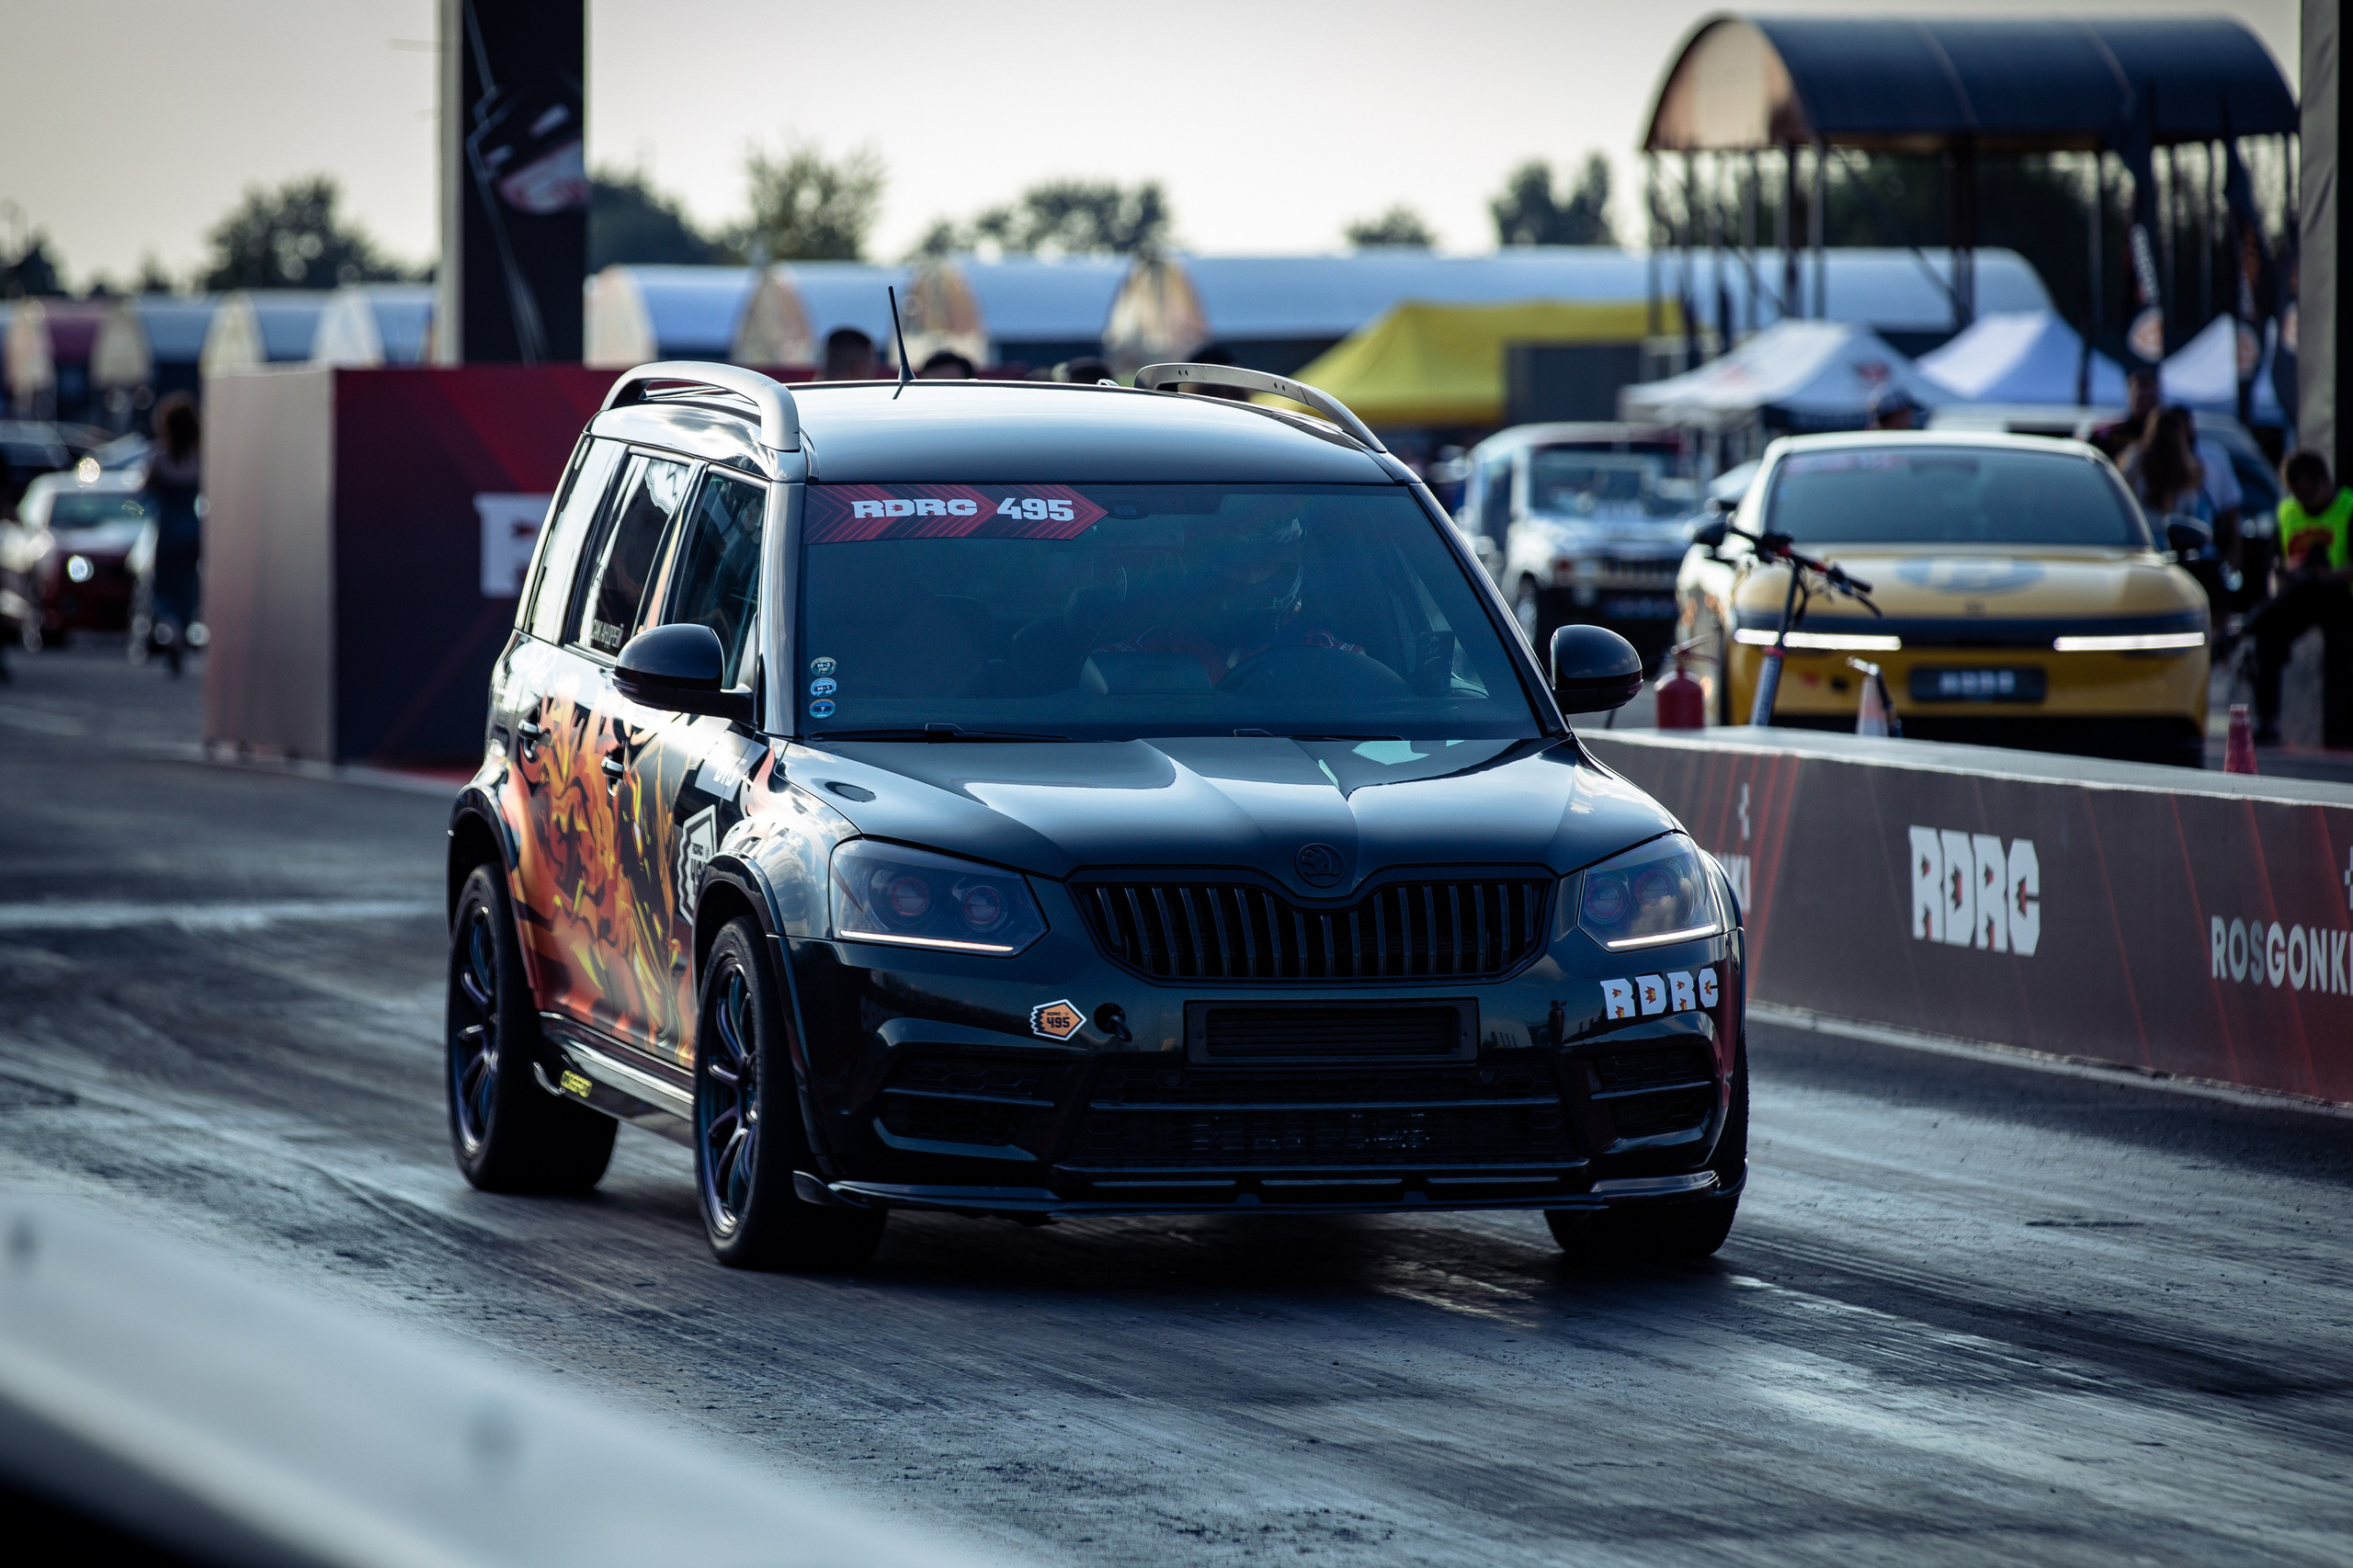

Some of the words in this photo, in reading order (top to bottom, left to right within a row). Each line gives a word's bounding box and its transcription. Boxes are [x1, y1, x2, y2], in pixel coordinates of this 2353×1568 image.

[851, 498, 977, 518] RDRC
[996, 497, 1074, 521] 495
[1909, 824, 2040, 957] RDRC
[1600, 968, 1719, 1019] RDRC
[1046, 1017, 1070, 1028] 495
